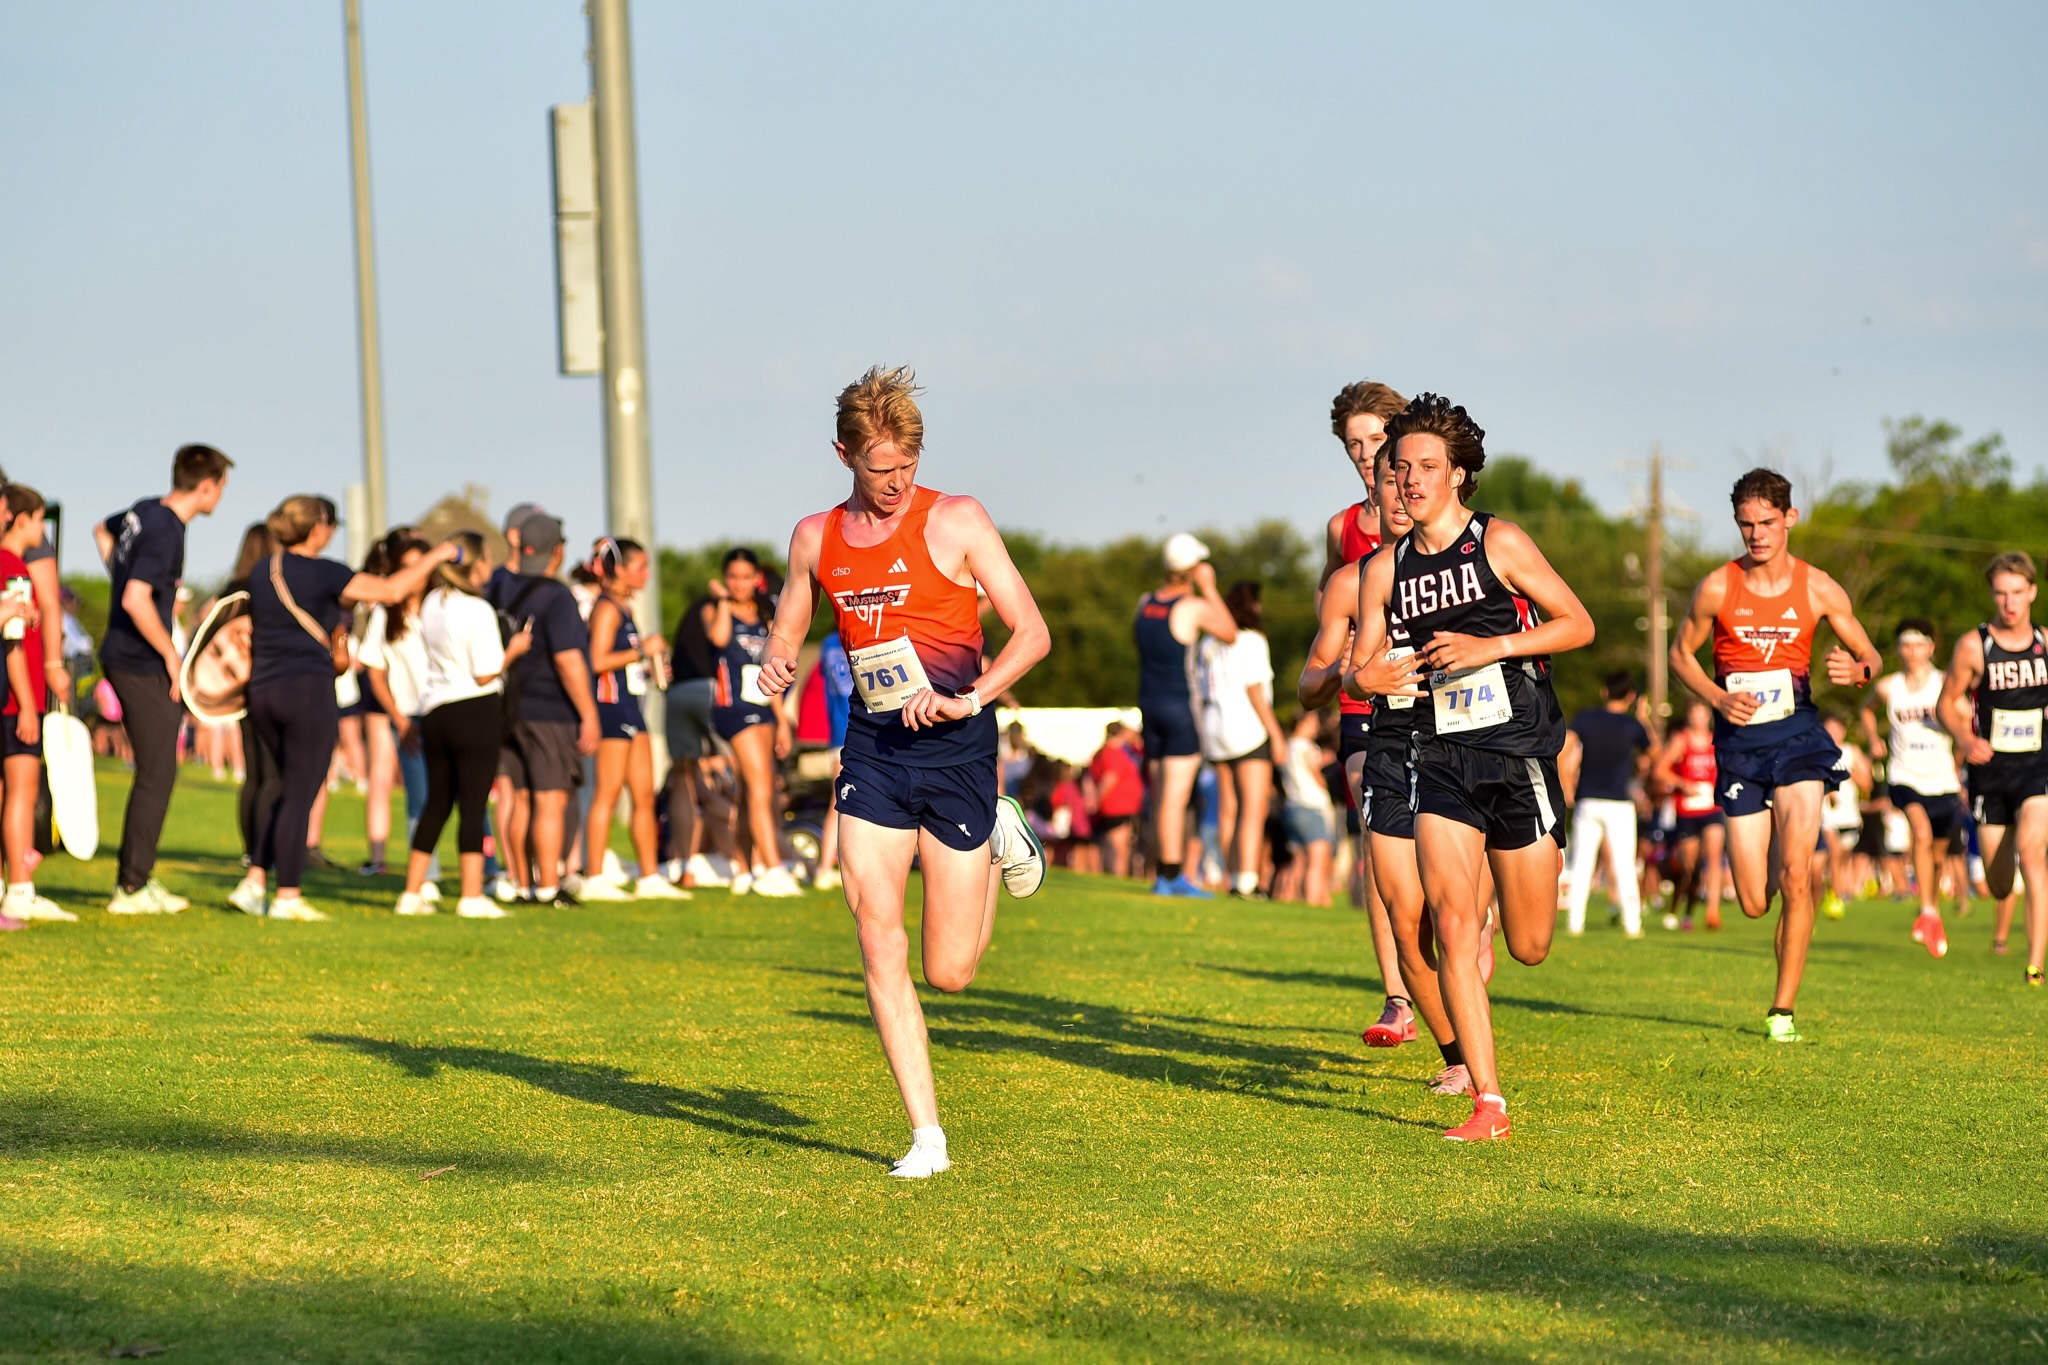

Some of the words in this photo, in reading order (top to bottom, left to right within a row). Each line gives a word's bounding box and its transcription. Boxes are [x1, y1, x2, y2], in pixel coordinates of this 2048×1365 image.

[832, 567, 851, 577] GISD
[1399, 562, 1486, 620] HSAA
[860, 664, 909, 691] 761
[1988, 657, 2048, 691] HSAA
[1444, 684, 1495, 709] 774
[1745, 688, 1782, 704] 47
